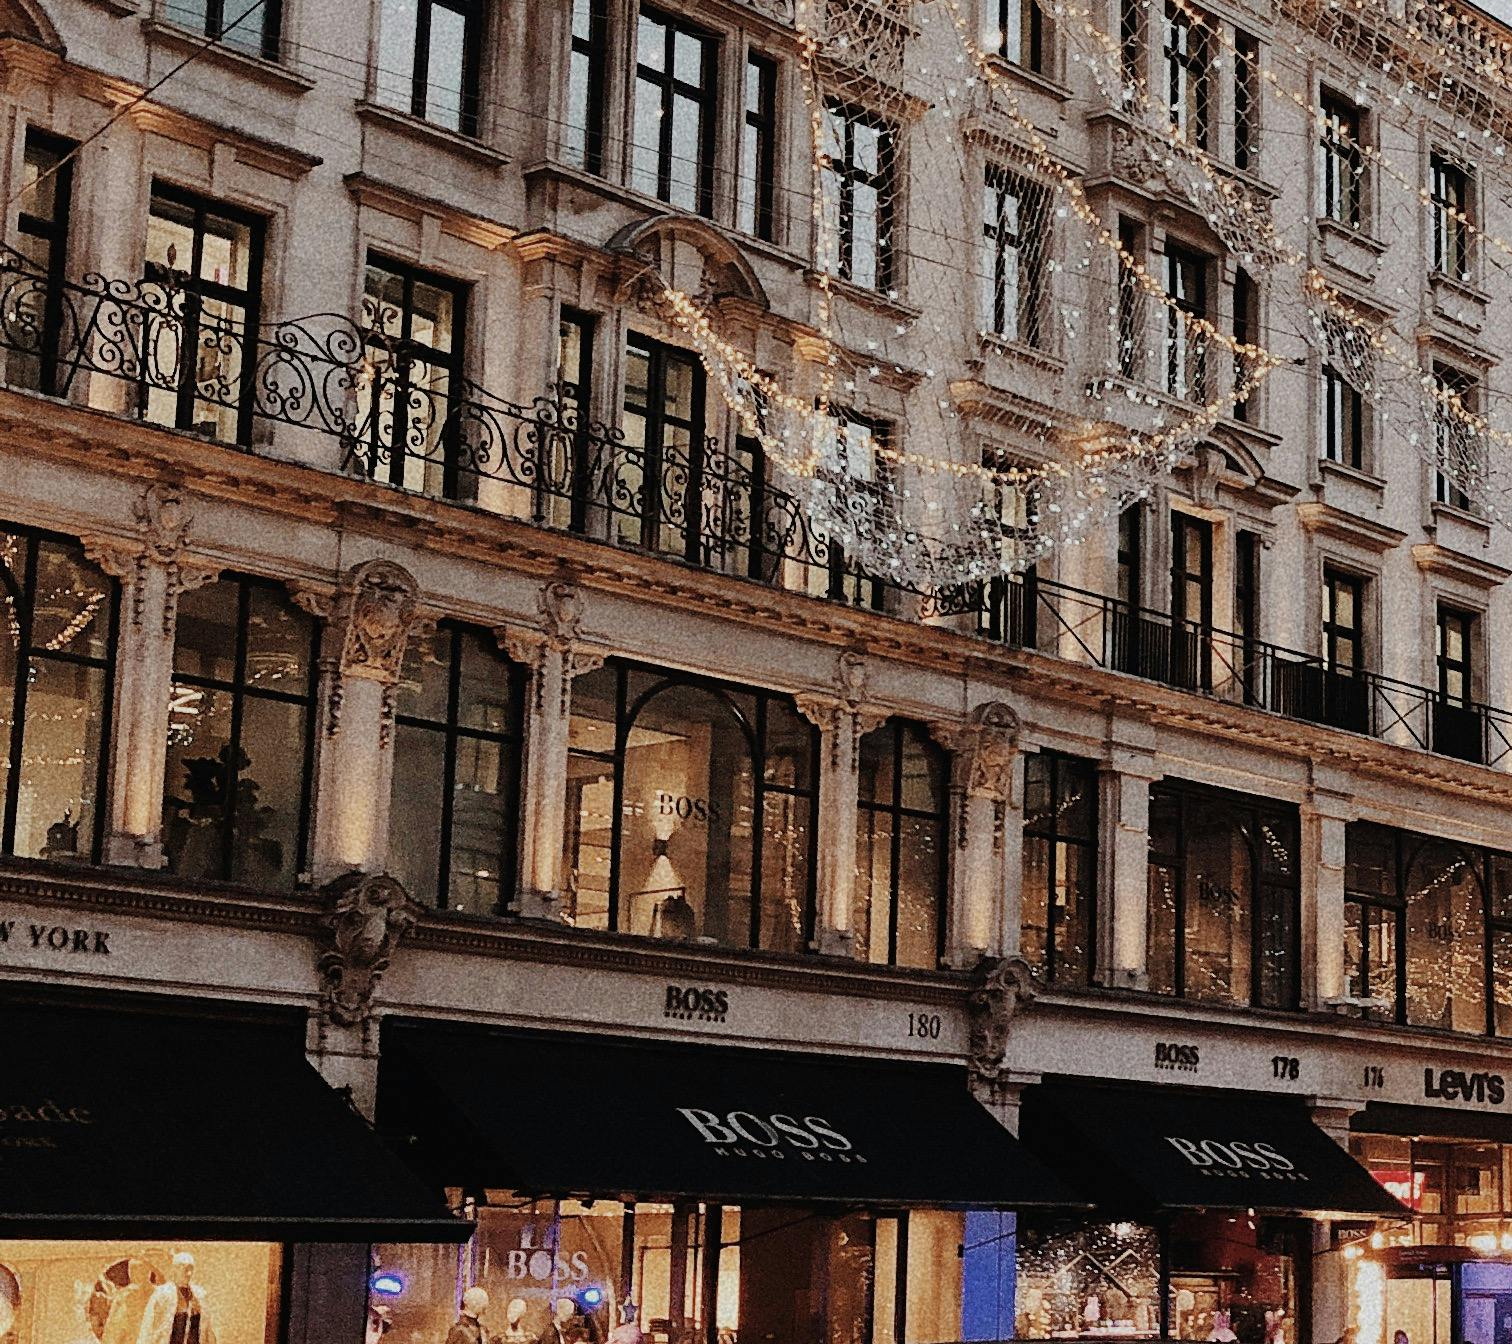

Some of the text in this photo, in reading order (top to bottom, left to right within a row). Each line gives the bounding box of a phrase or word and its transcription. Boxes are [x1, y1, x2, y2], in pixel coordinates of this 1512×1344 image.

[30, 924, 111, 954] YORK
[665, 985, 729, 1014] BOSS
[907, 1013, 941, 1040] 180
[1154, 1043, 1199, 1065] BOSS
[1271, 1056, 1300, 1080] 178
[675, 1107, 852, 1150] BOSS
[1164, 1136, 1294, 1170] BOSS
